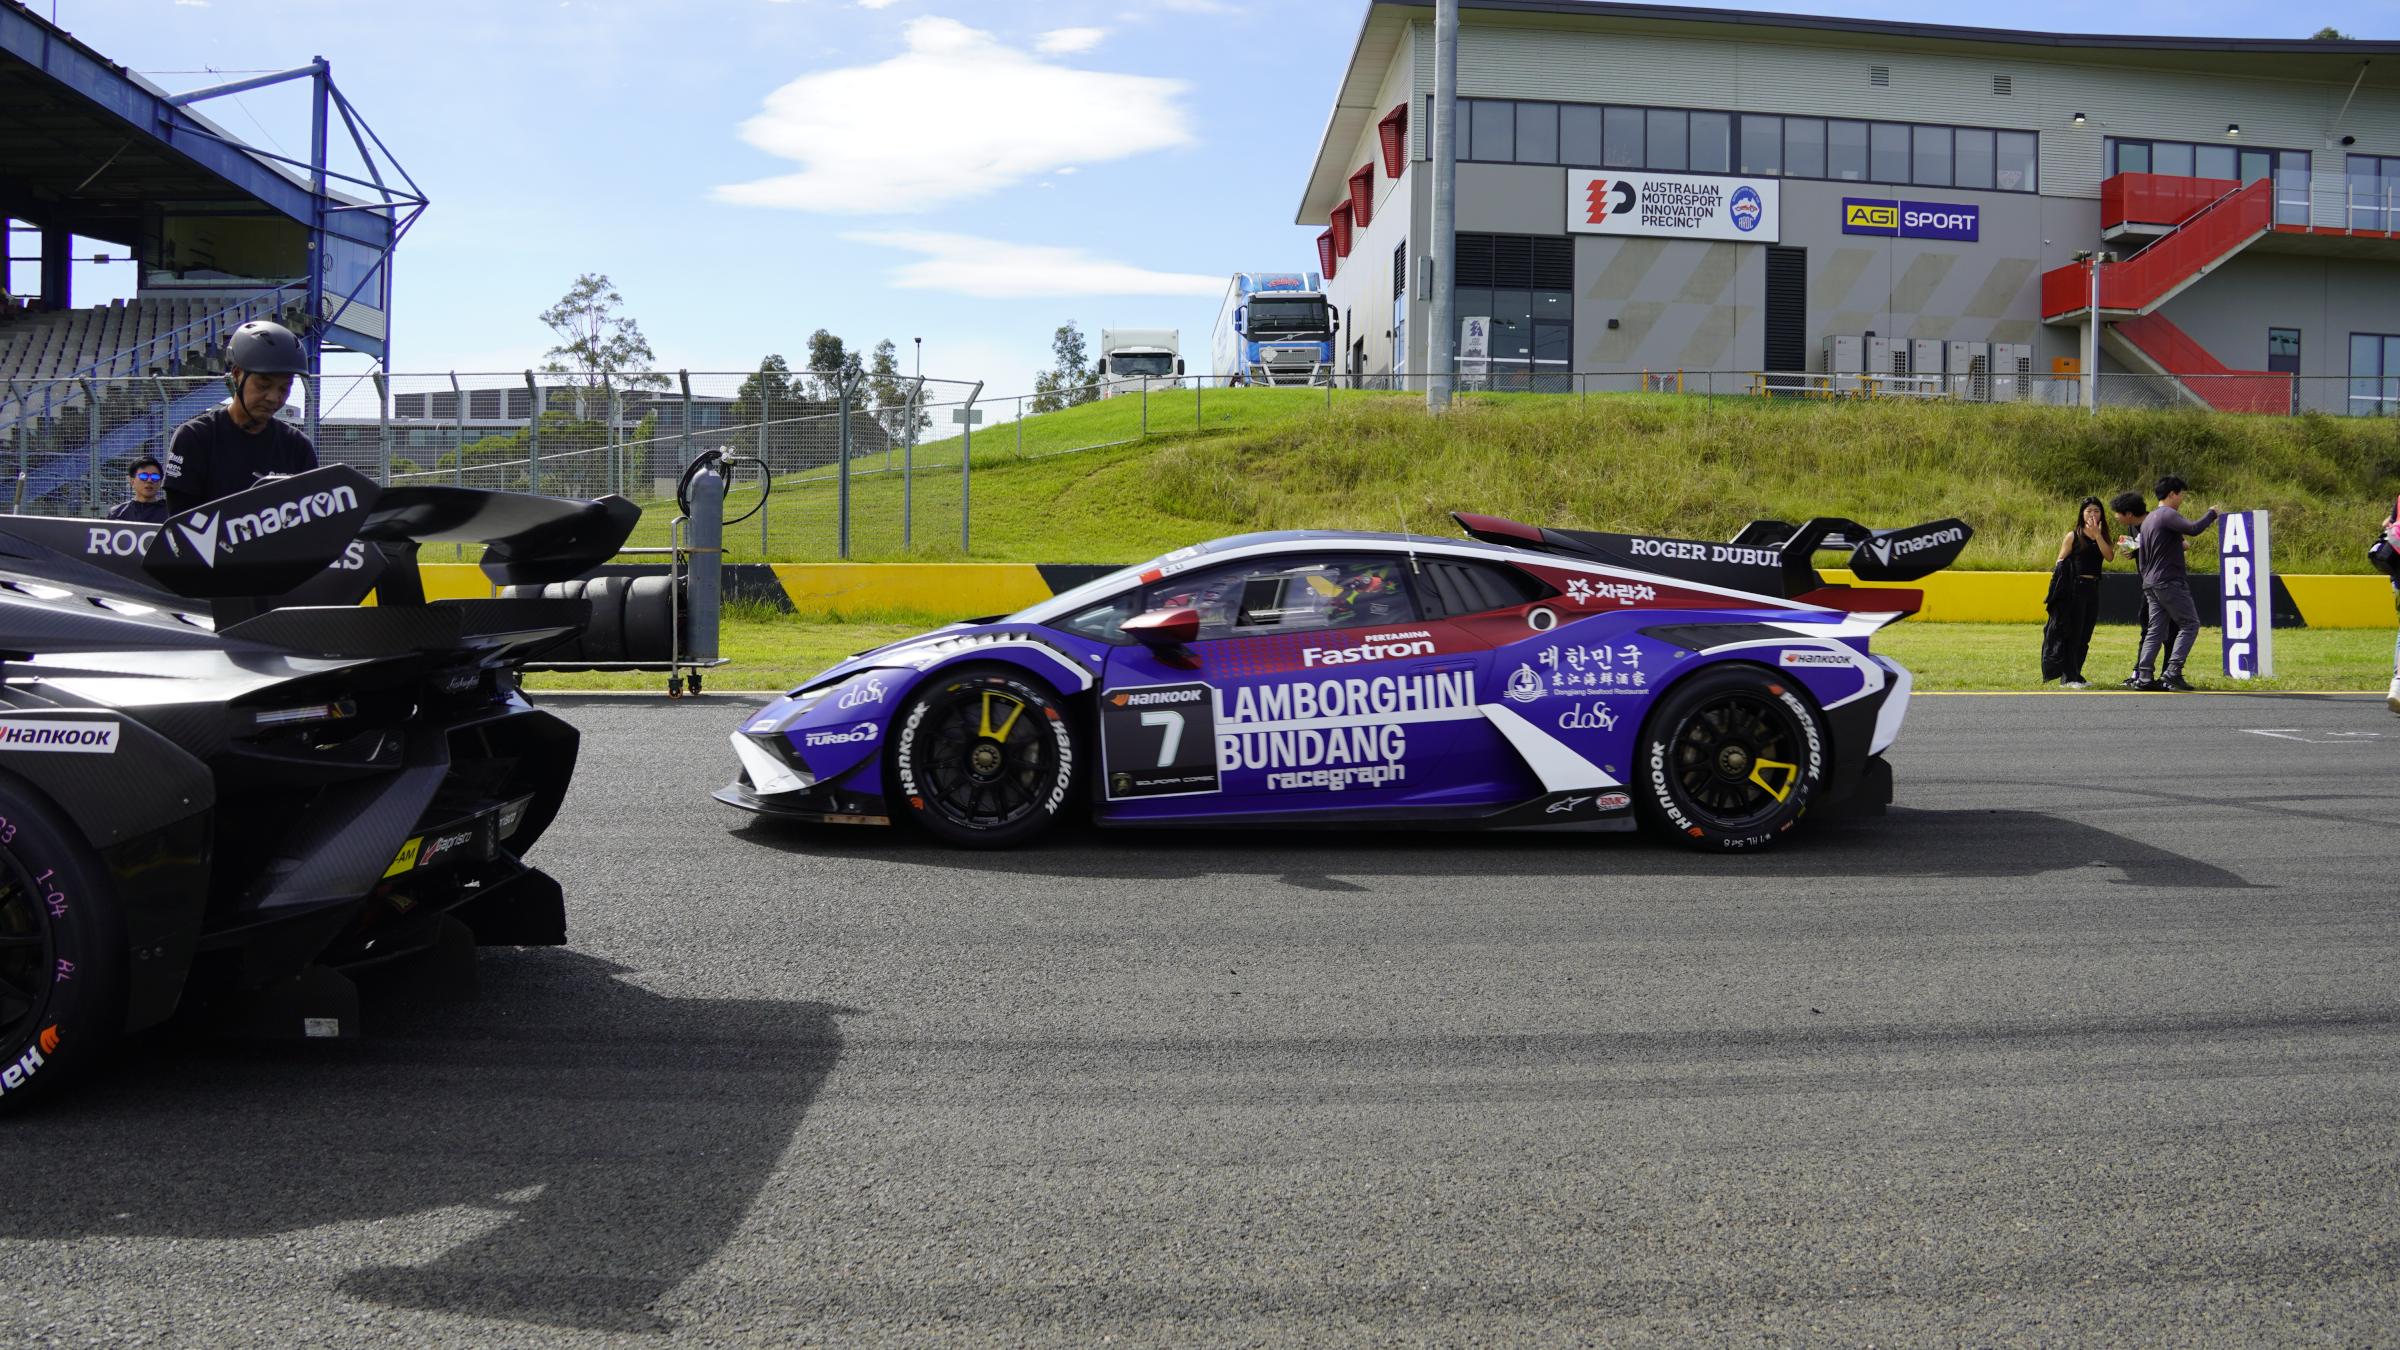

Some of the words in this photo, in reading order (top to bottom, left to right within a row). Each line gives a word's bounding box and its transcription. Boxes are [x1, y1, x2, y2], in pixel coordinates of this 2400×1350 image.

[1641, 193, 1723, 207] MOTORSPORT
[1642, 181, 1719, 195] AUSTRALIAN
[1641, 204, 1714, 218] INNOVATION
[1641, 215, 1701, 229] PRECINCT
[1850, 208, 1894, 225] AGI
[1904, 211, 1975, 230] SPORT
[225, 485, 359, 545] macron
[1630, 538, 1707, 561] ROGER
[1711, 545, 1782, 567] DUBUI
[1893, 527, 1963, 556] macron
[1595, 581, 1656, 605] 차란차
[2222, 512, 2252, 680] ARDC
[1364, 630, 1431, 642] PERTAMINA
[1302, 640, 1436, 667] Fastron
[1538, 644, 1643, 671] 대한민국
[1214, 670, 1476, 724] LAMBORGHINI
[1140, 710, 1185, 767] 7
[1217, 724, 1407, 771] BUNDANG
[1266, 758, 1406, 791] racegraph
